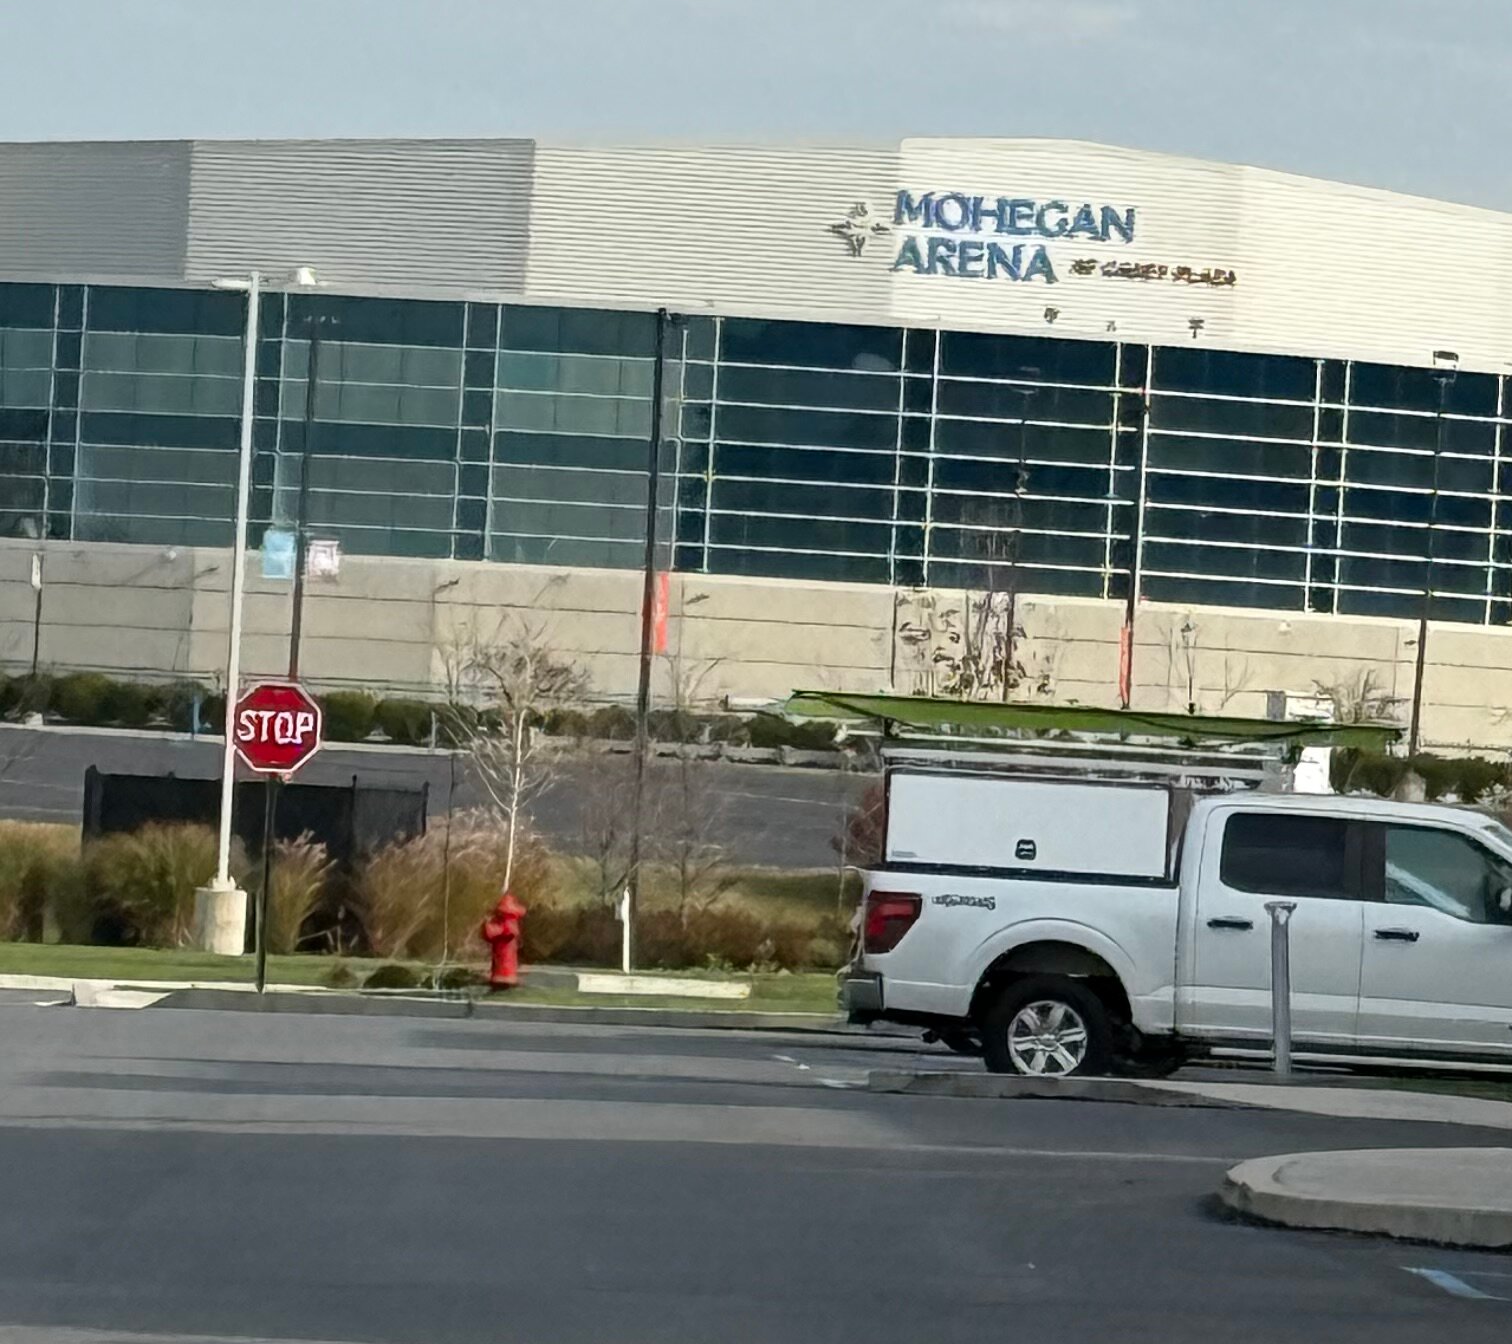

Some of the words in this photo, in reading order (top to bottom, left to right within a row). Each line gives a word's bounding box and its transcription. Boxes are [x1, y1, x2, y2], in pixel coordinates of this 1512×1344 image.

[893, 190, 1136, 243] MOHEGAN
[889, 235, 1059, 284] ARENA
[237, 709, 314, 744] STOP
